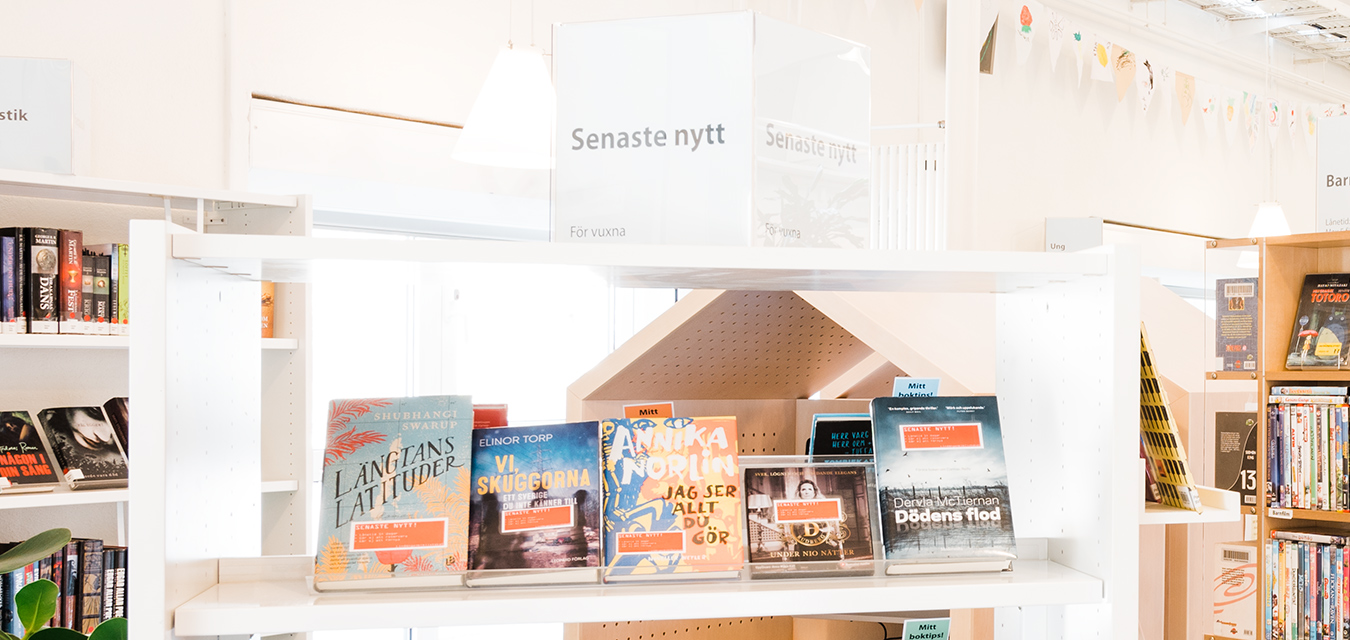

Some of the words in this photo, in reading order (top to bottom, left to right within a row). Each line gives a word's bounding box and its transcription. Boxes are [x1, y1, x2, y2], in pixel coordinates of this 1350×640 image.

[571, 127, 667, 151] Senaste
[674, 123, 725, 152] nytt
[765, 122, 826, 159] Senaste
[828, 142, 857, 166] nytt
[1325, 218, 1350, 226] Lånetid:
[570, 225, 588, 238] För
[591, 226, 626, 238] vuxna
[765, 222, 777, 236] För
[778, 226, 801, 239] vuxna
[1050, 243, 1066, 251] Ung
[40, 277, 49, 310] DANS
[1311, 293, 1350, 303] TOTORO
[374, 410, 457, 421] SHUBHANGI
[639, 408, 659, 416] Mitt
[402, 420, 458, 431] SWARUP
[479, 435, 520, 447] ELINOR
[523, 433, 553, 443] TORP
[831, 432, 849, 440] HERR
[852, 430, 869, 439] VARG
[0, 452, 38, 465] NÅGON
[39, 453, 46, 464] I
[495, 455, 519, 475] VI,
[20, 464, 52, 476] SÄNG
[334, 436, 455, 500] LÄNGTANS
[477, 469, 591, 496] SKUGGORNA
[1240, 470, 1256, 490] 13
[335, 456, 464, 529] LATITUDER
[503, 494, 516, 502] ETT
[517, 491, 548, 501] SVERIGE
[662, 485, 698, 500] JAG
[703, 485, 737, 498] SER
[534, 498, 563, 508] KÄNNER
[564, 497, 578, 506] TILL
[672, 501, 719, 516] ALLT
[893, 498, 933, 508] Dervla
[936, 496, 999, 507] McTiernan
[895, 508, 963, 524] Dödens
[966, 507, 1000, 522] flod
[683, 516, 710, 530] DU
[692, 526, 730, 546] GÖR
[909, 632, 943, 640] boktips!
